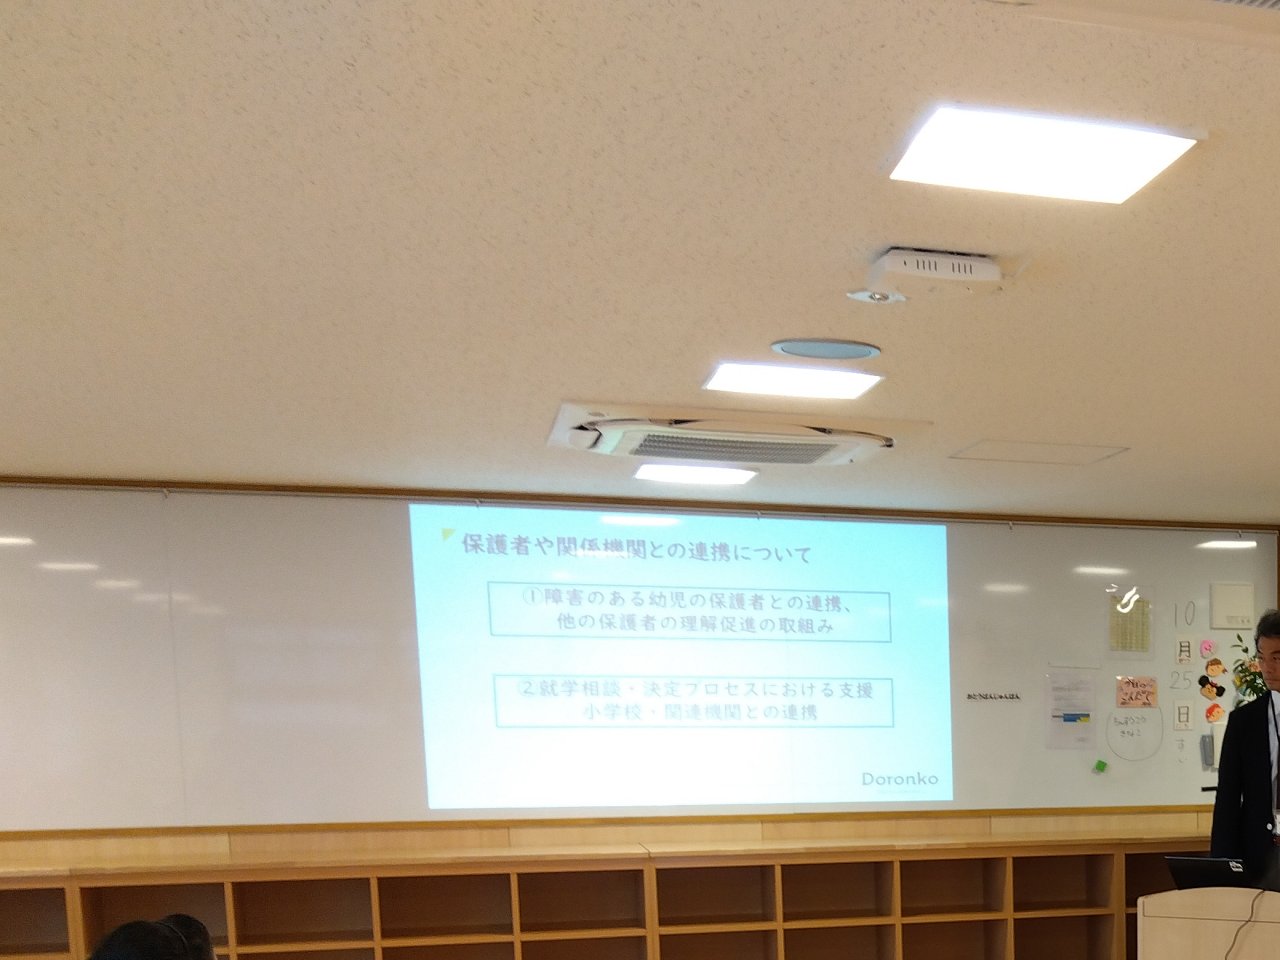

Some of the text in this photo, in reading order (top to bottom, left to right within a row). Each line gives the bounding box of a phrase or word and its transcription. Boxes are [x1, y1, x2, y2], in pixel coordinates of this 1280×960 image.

[557, 612, 834, 634] 他の保護者の理解促進の取組み
[1174, 601, 1195, 628] 10
[1179, 641, 1191, 658] 月
[1169, 670, 1193, 689] 25
[1178, 706, 1189, 722] 日
[862, 772, 939, 786] Doronko
